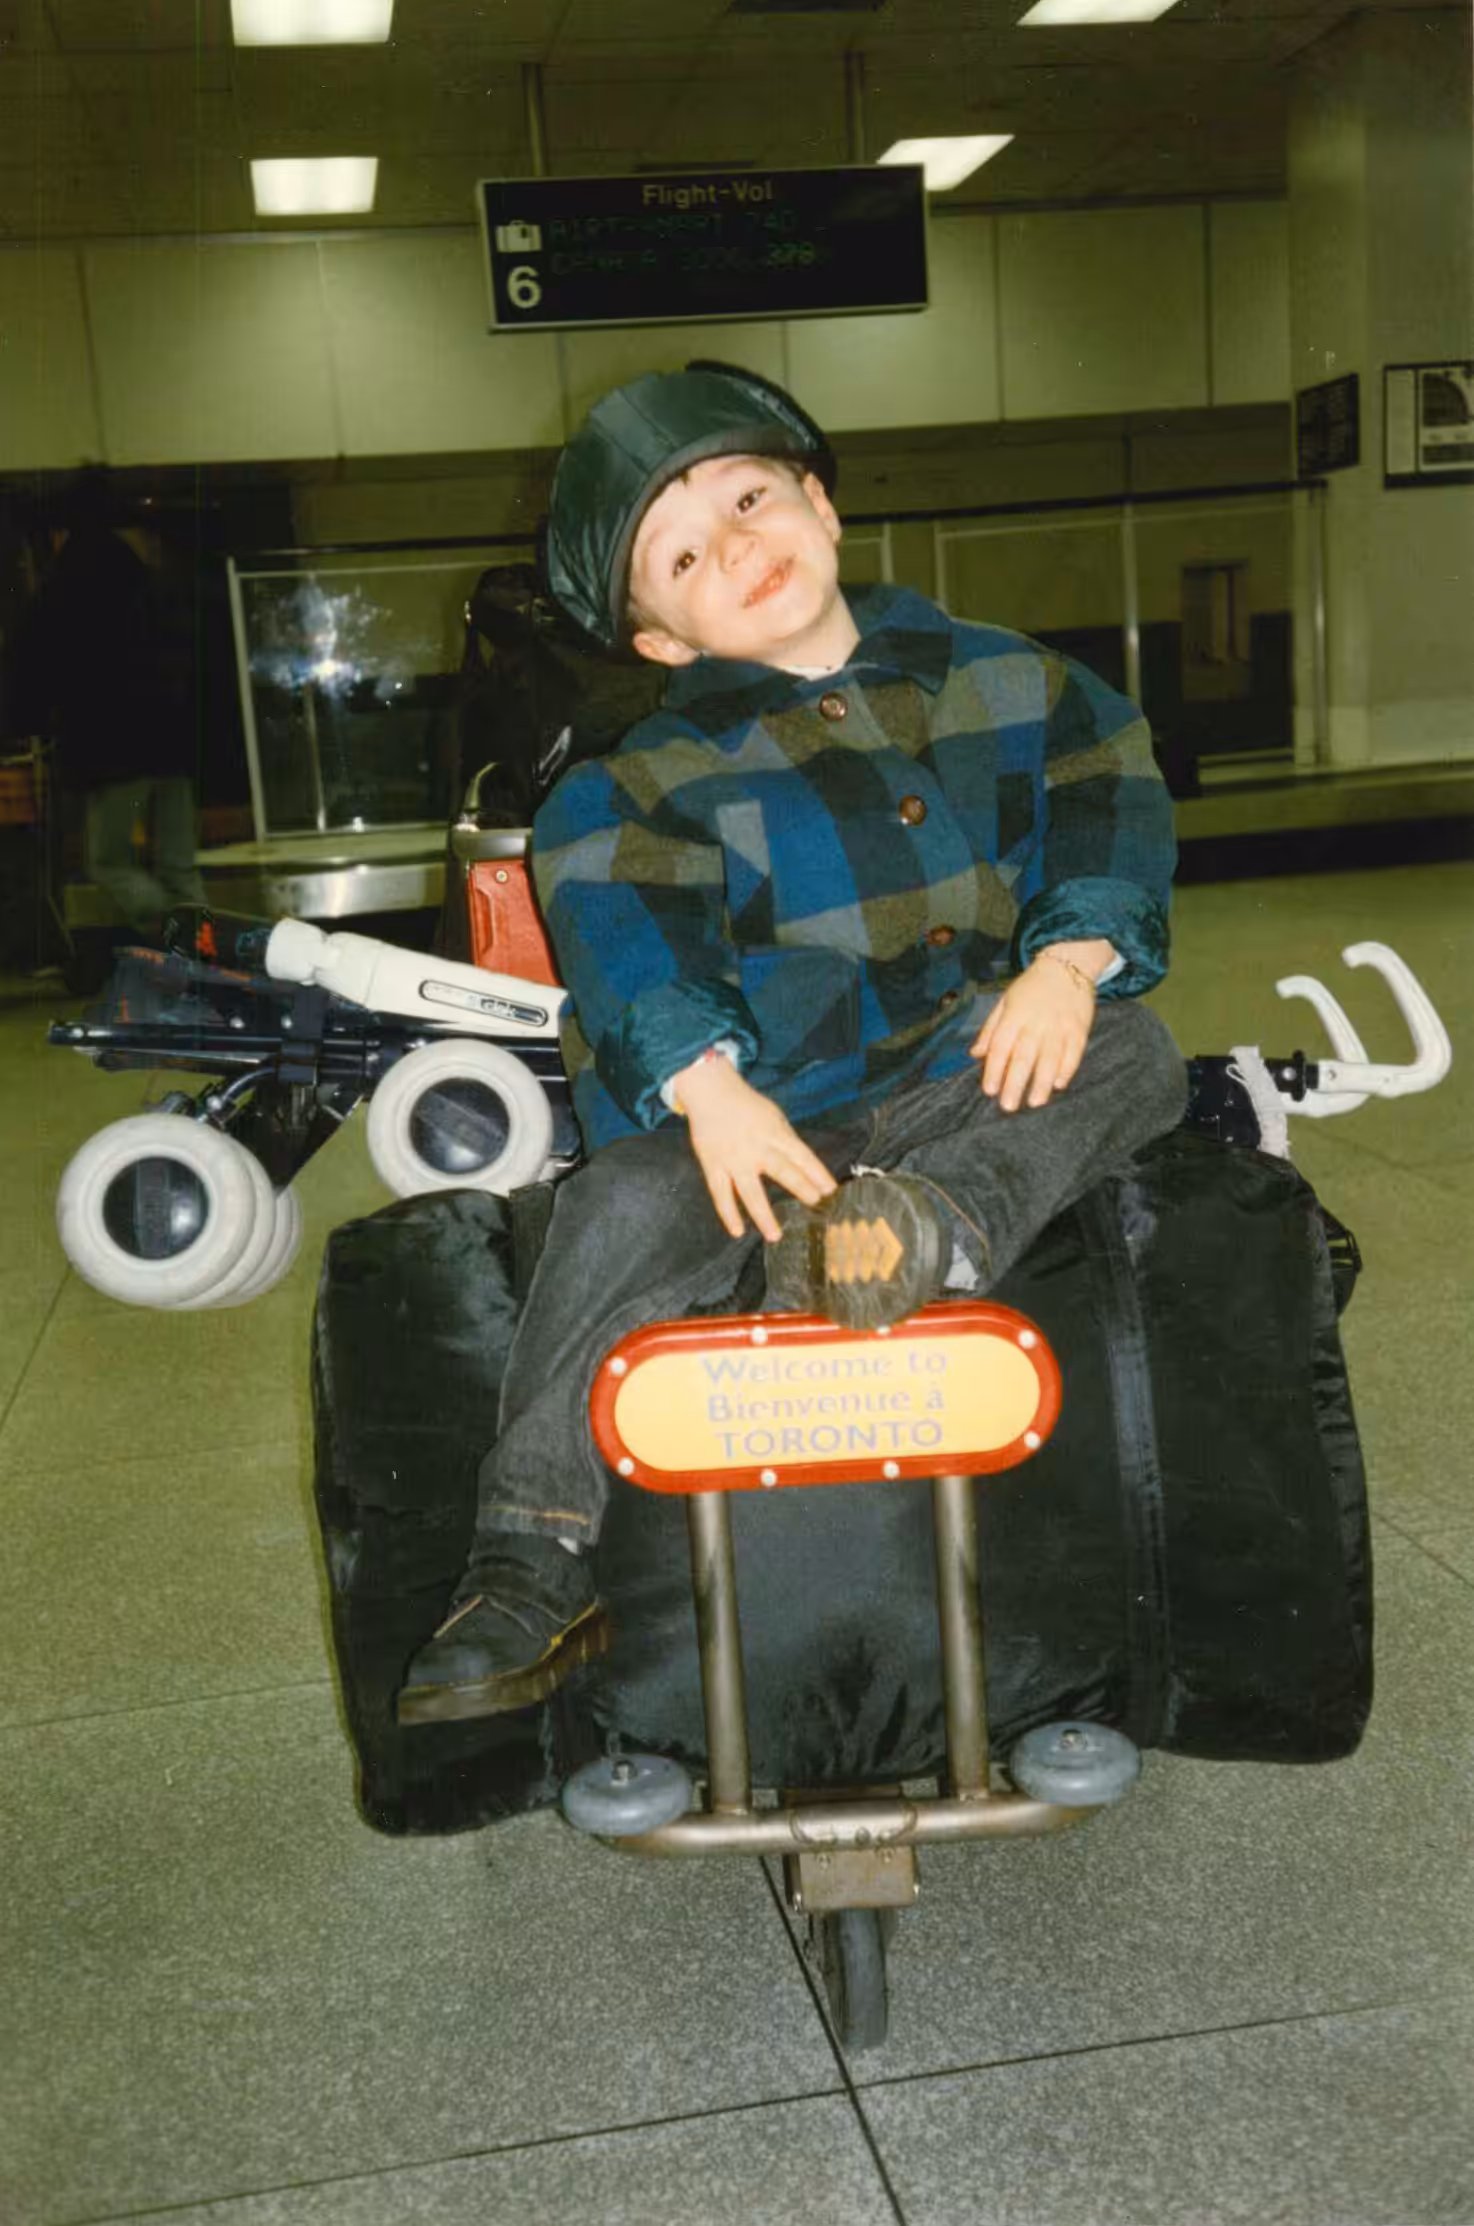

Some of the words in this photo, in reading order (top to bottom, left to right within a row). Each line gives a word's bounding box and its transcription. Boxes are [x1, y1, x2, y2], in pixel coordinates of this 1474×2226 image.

[642, 181, 773, 209] Flight-Vol
[507, 265, 542, 309] 6
[702, 1354, 892, 1384] Welcome
[908, 1351, 948, 1374] to
[708, 1390, 912, 1422] Bienvenue
[714, 1418, 945, 1459] TORONTO
